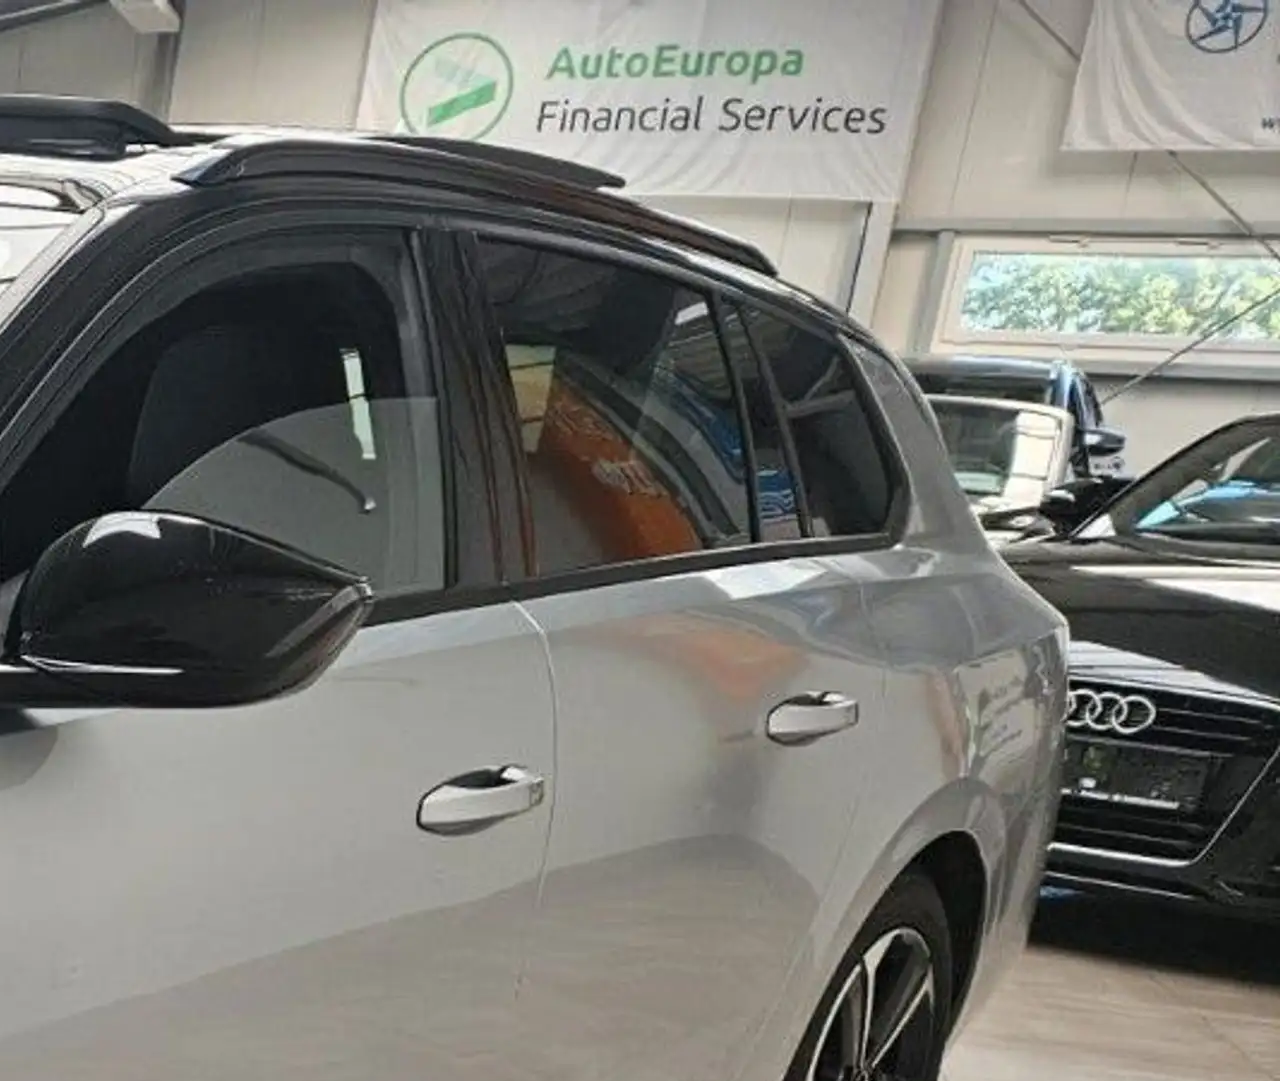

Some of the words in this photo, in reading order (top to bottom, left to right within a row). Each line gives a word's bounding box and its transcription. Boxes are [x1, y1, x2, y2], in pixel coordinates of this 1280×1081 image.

[545, 44, 805, 84] AutoEuropa
[536, 95, 703, 133] Financial
[718, 96, 888, 134] Services
